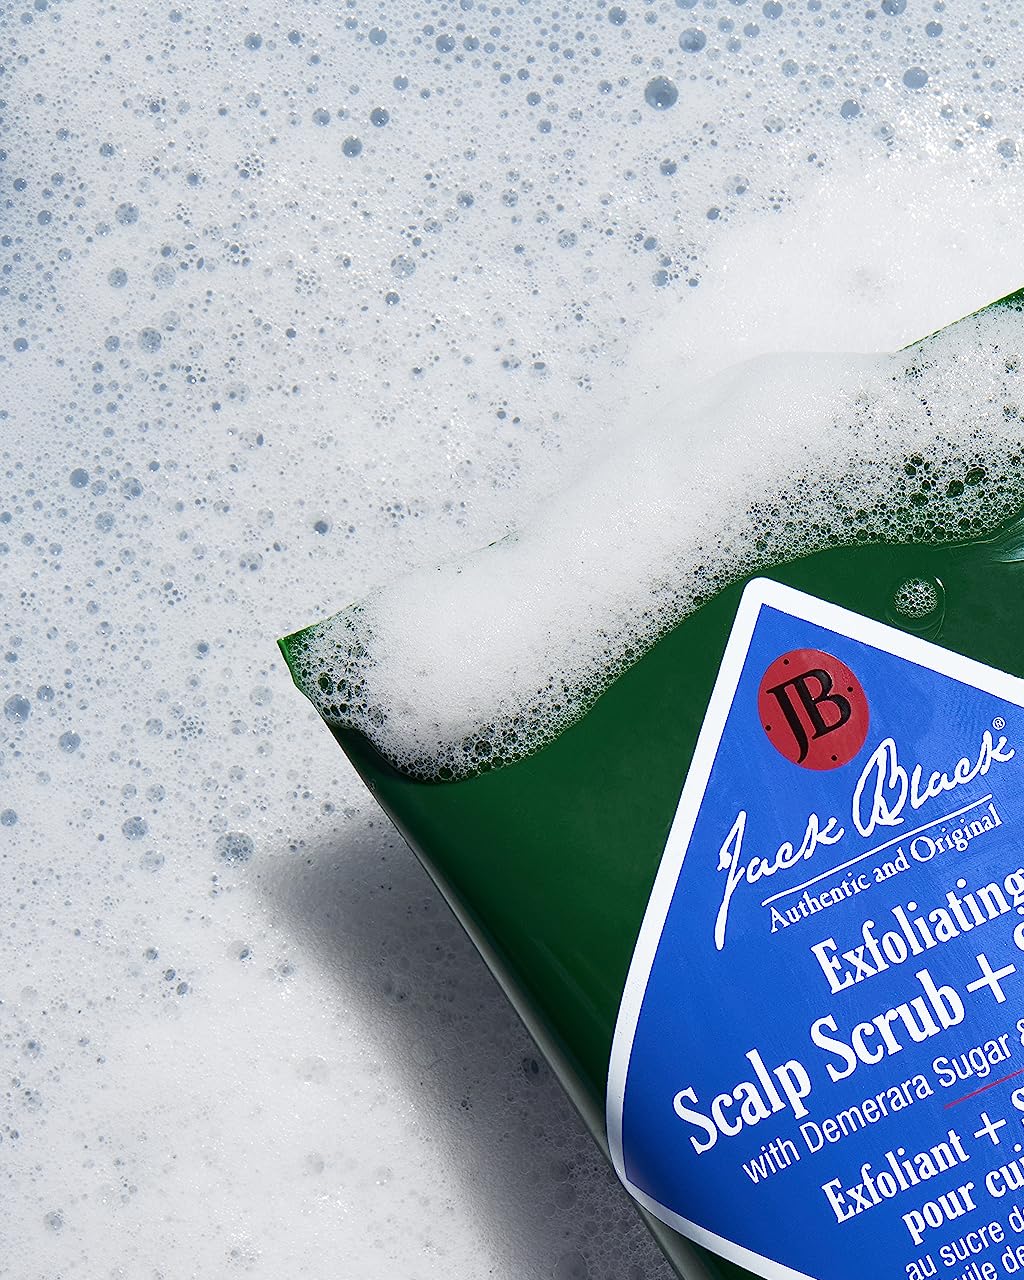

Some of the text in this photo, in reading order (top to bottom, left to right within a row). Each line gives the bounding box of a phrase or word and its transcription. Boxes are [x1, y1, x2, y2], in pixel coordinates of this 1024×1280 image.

[766, 668, 852, 764] JB
[715, 811, 844, 950] Jack
[770, 803, 1002, 933] Authentic and Original
[673, 1049, 811, 1154] Scalp
[811, 969, 964, 1082] Scrub
[966, 954, 1016, 1003] +
[743, 1138, 800, 1183] with
[800, 1075, 934, 1153] Demerara
[933, 1034, 1011, 1087] Sugar
[822, 1130, 970, 1223] Exfoliant
[974, 1113, 1006, 1145] +
[902, 1182, 976, 1245] pour
[940, 1222, 1004, 1266] sucre
